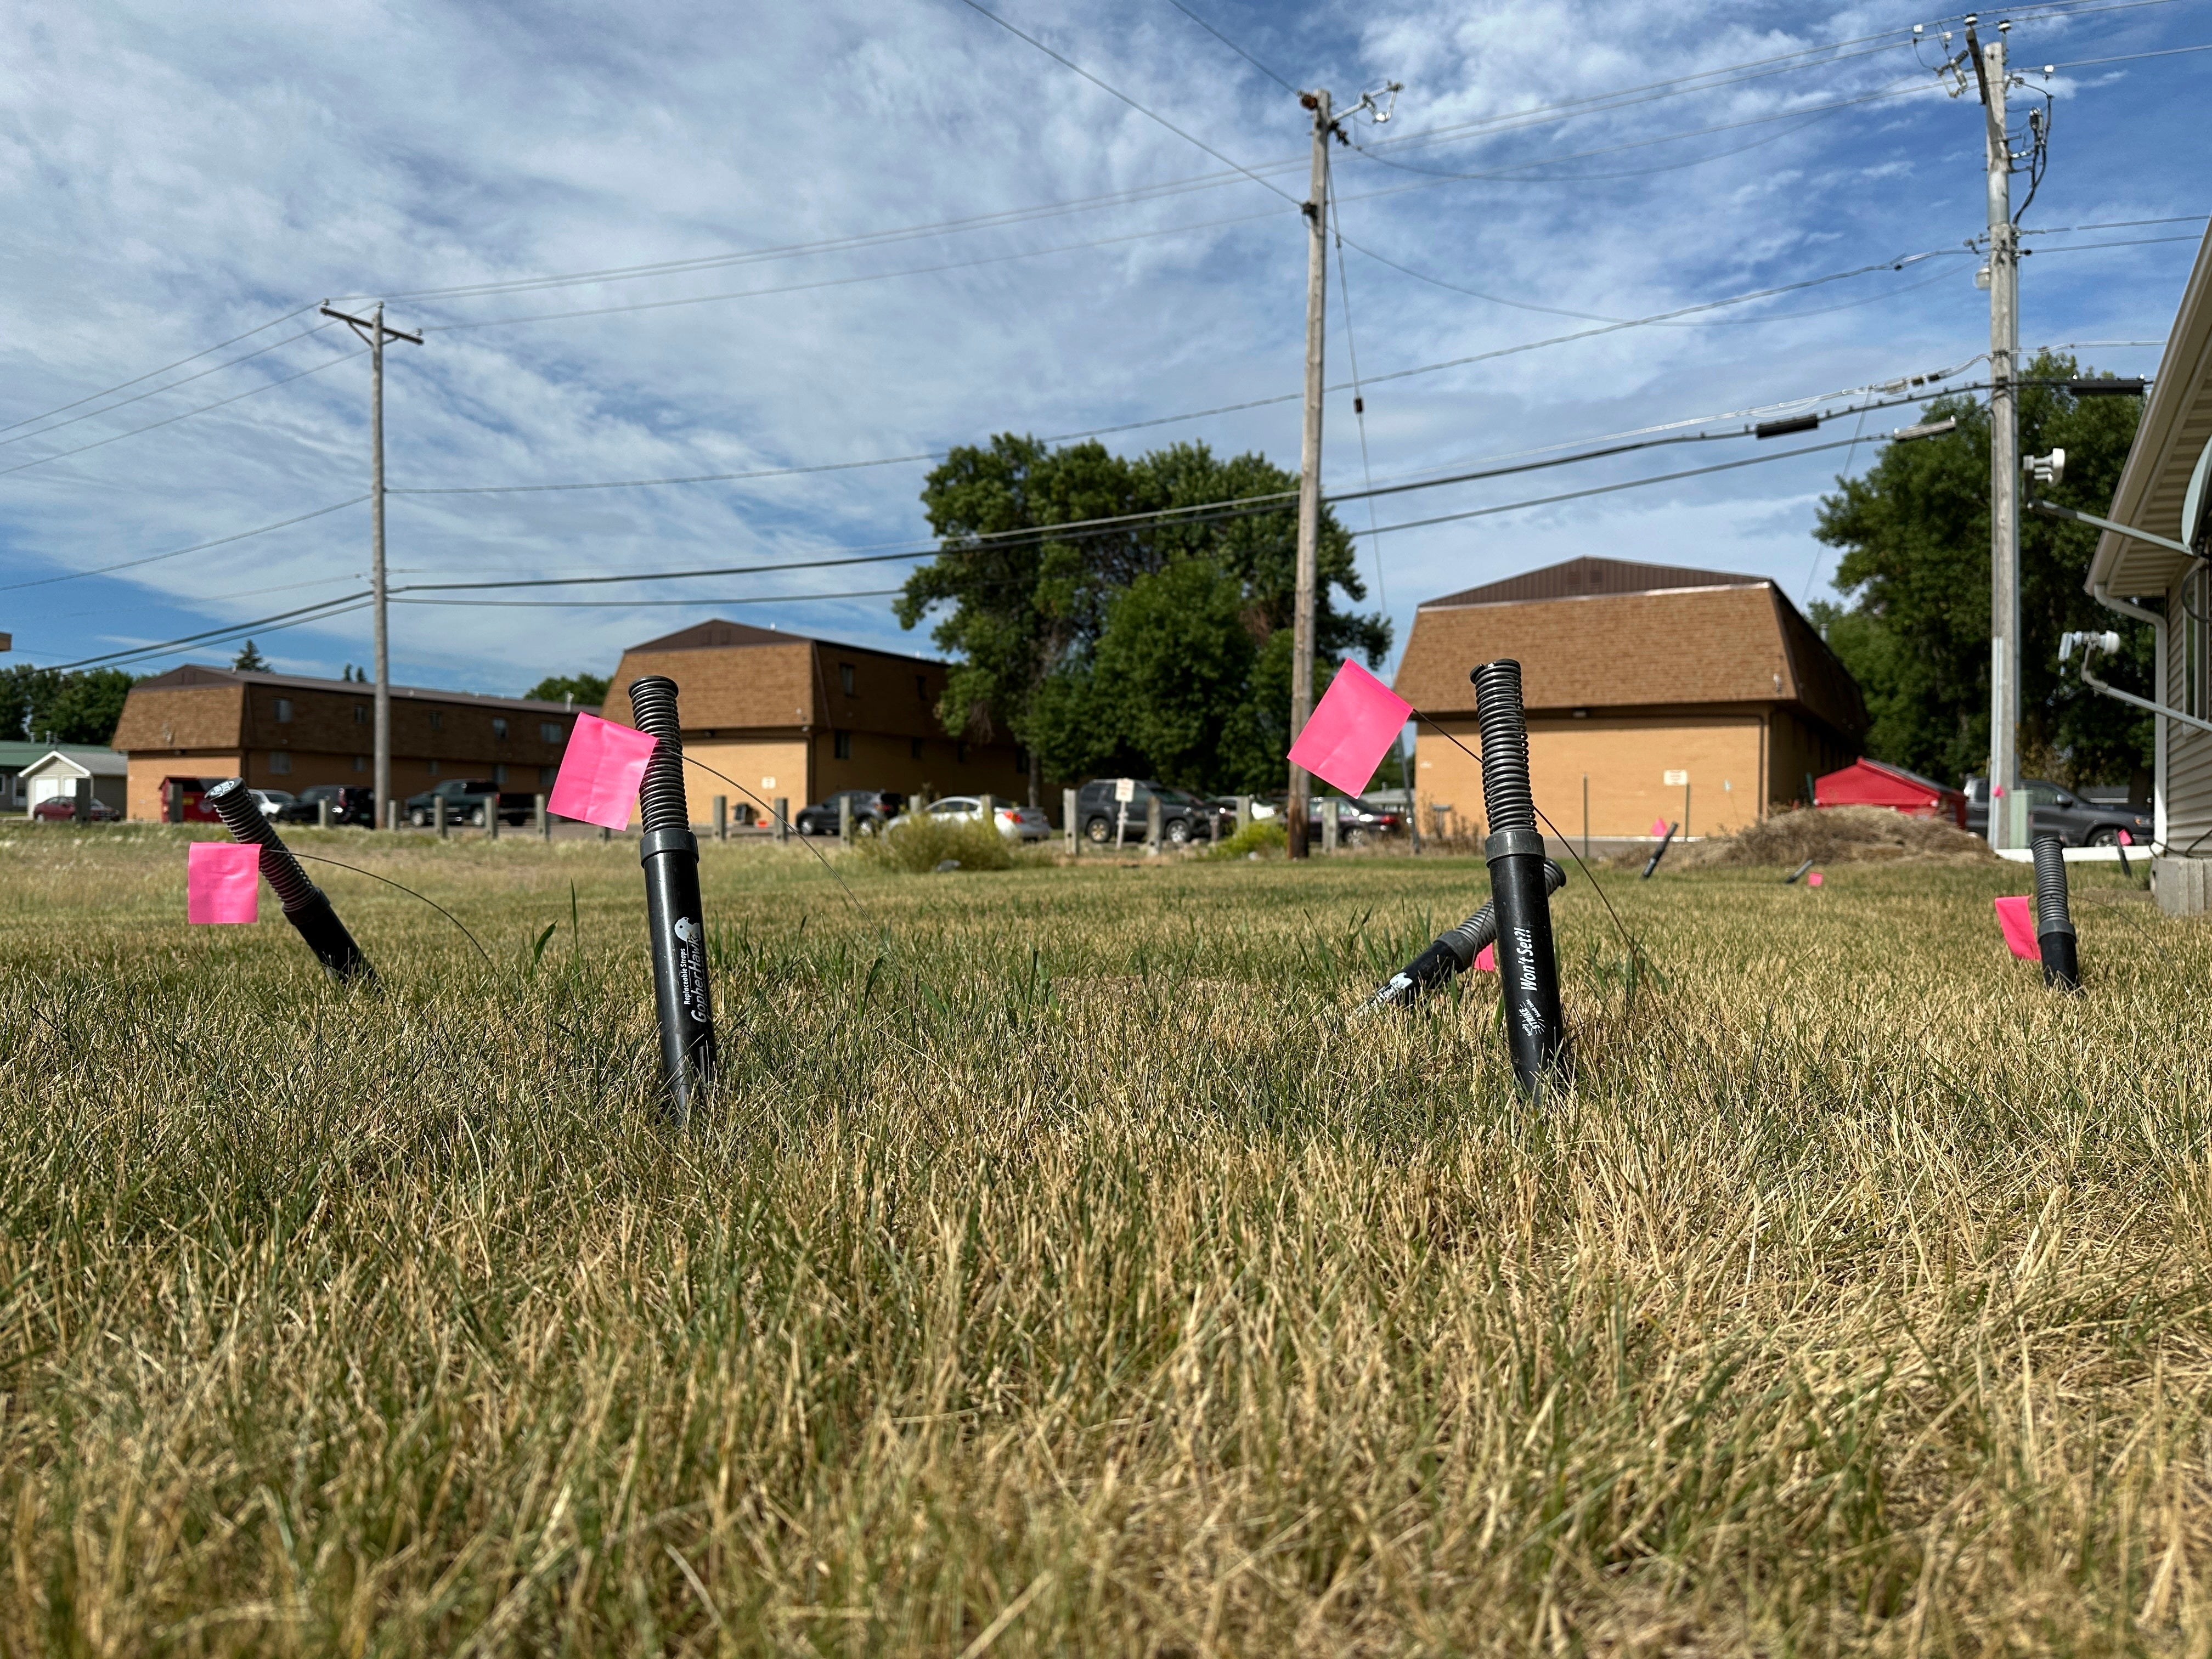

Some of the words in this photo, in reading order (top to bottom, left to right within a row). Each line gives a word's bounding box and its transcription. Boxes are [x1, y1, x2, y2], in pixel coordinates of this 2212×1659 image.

[1514, 927, 1533, 957] Set?!
[680, 968, 691, 1005] Replaceable
[688, 935, 708, 1023] GopherHawk
[1517, 957, 1537, 991] Won't
[1519, 1007, 1541, 1029] STRIKE
[1531, 1007, 1542, 1018] black
